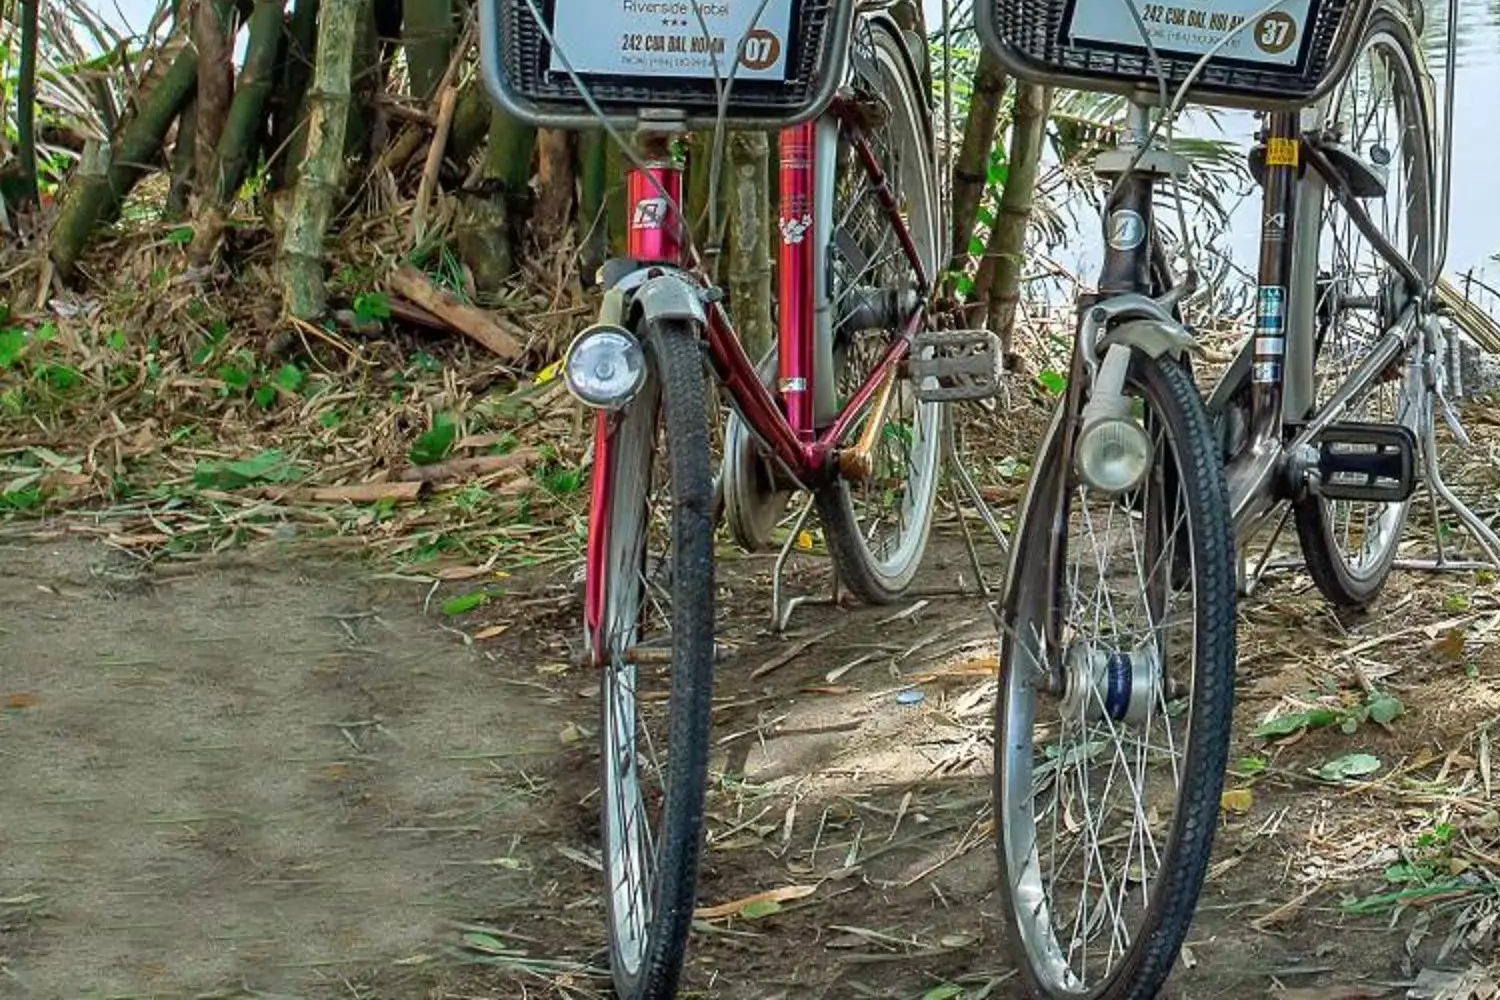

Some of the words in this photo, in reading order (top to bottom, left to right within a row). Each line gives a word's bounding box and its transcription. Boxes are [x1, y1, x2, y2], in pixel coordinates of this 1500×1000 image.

[623, 0, 687, 14] Riverside
[691, 1, 729, 16] Hotel
[1142, 3, 1164, 23] 242
[621, 34, 642, 50] 242
[1262, 19, 1289, 46] 37
[745, 37, 772, 62] 07
